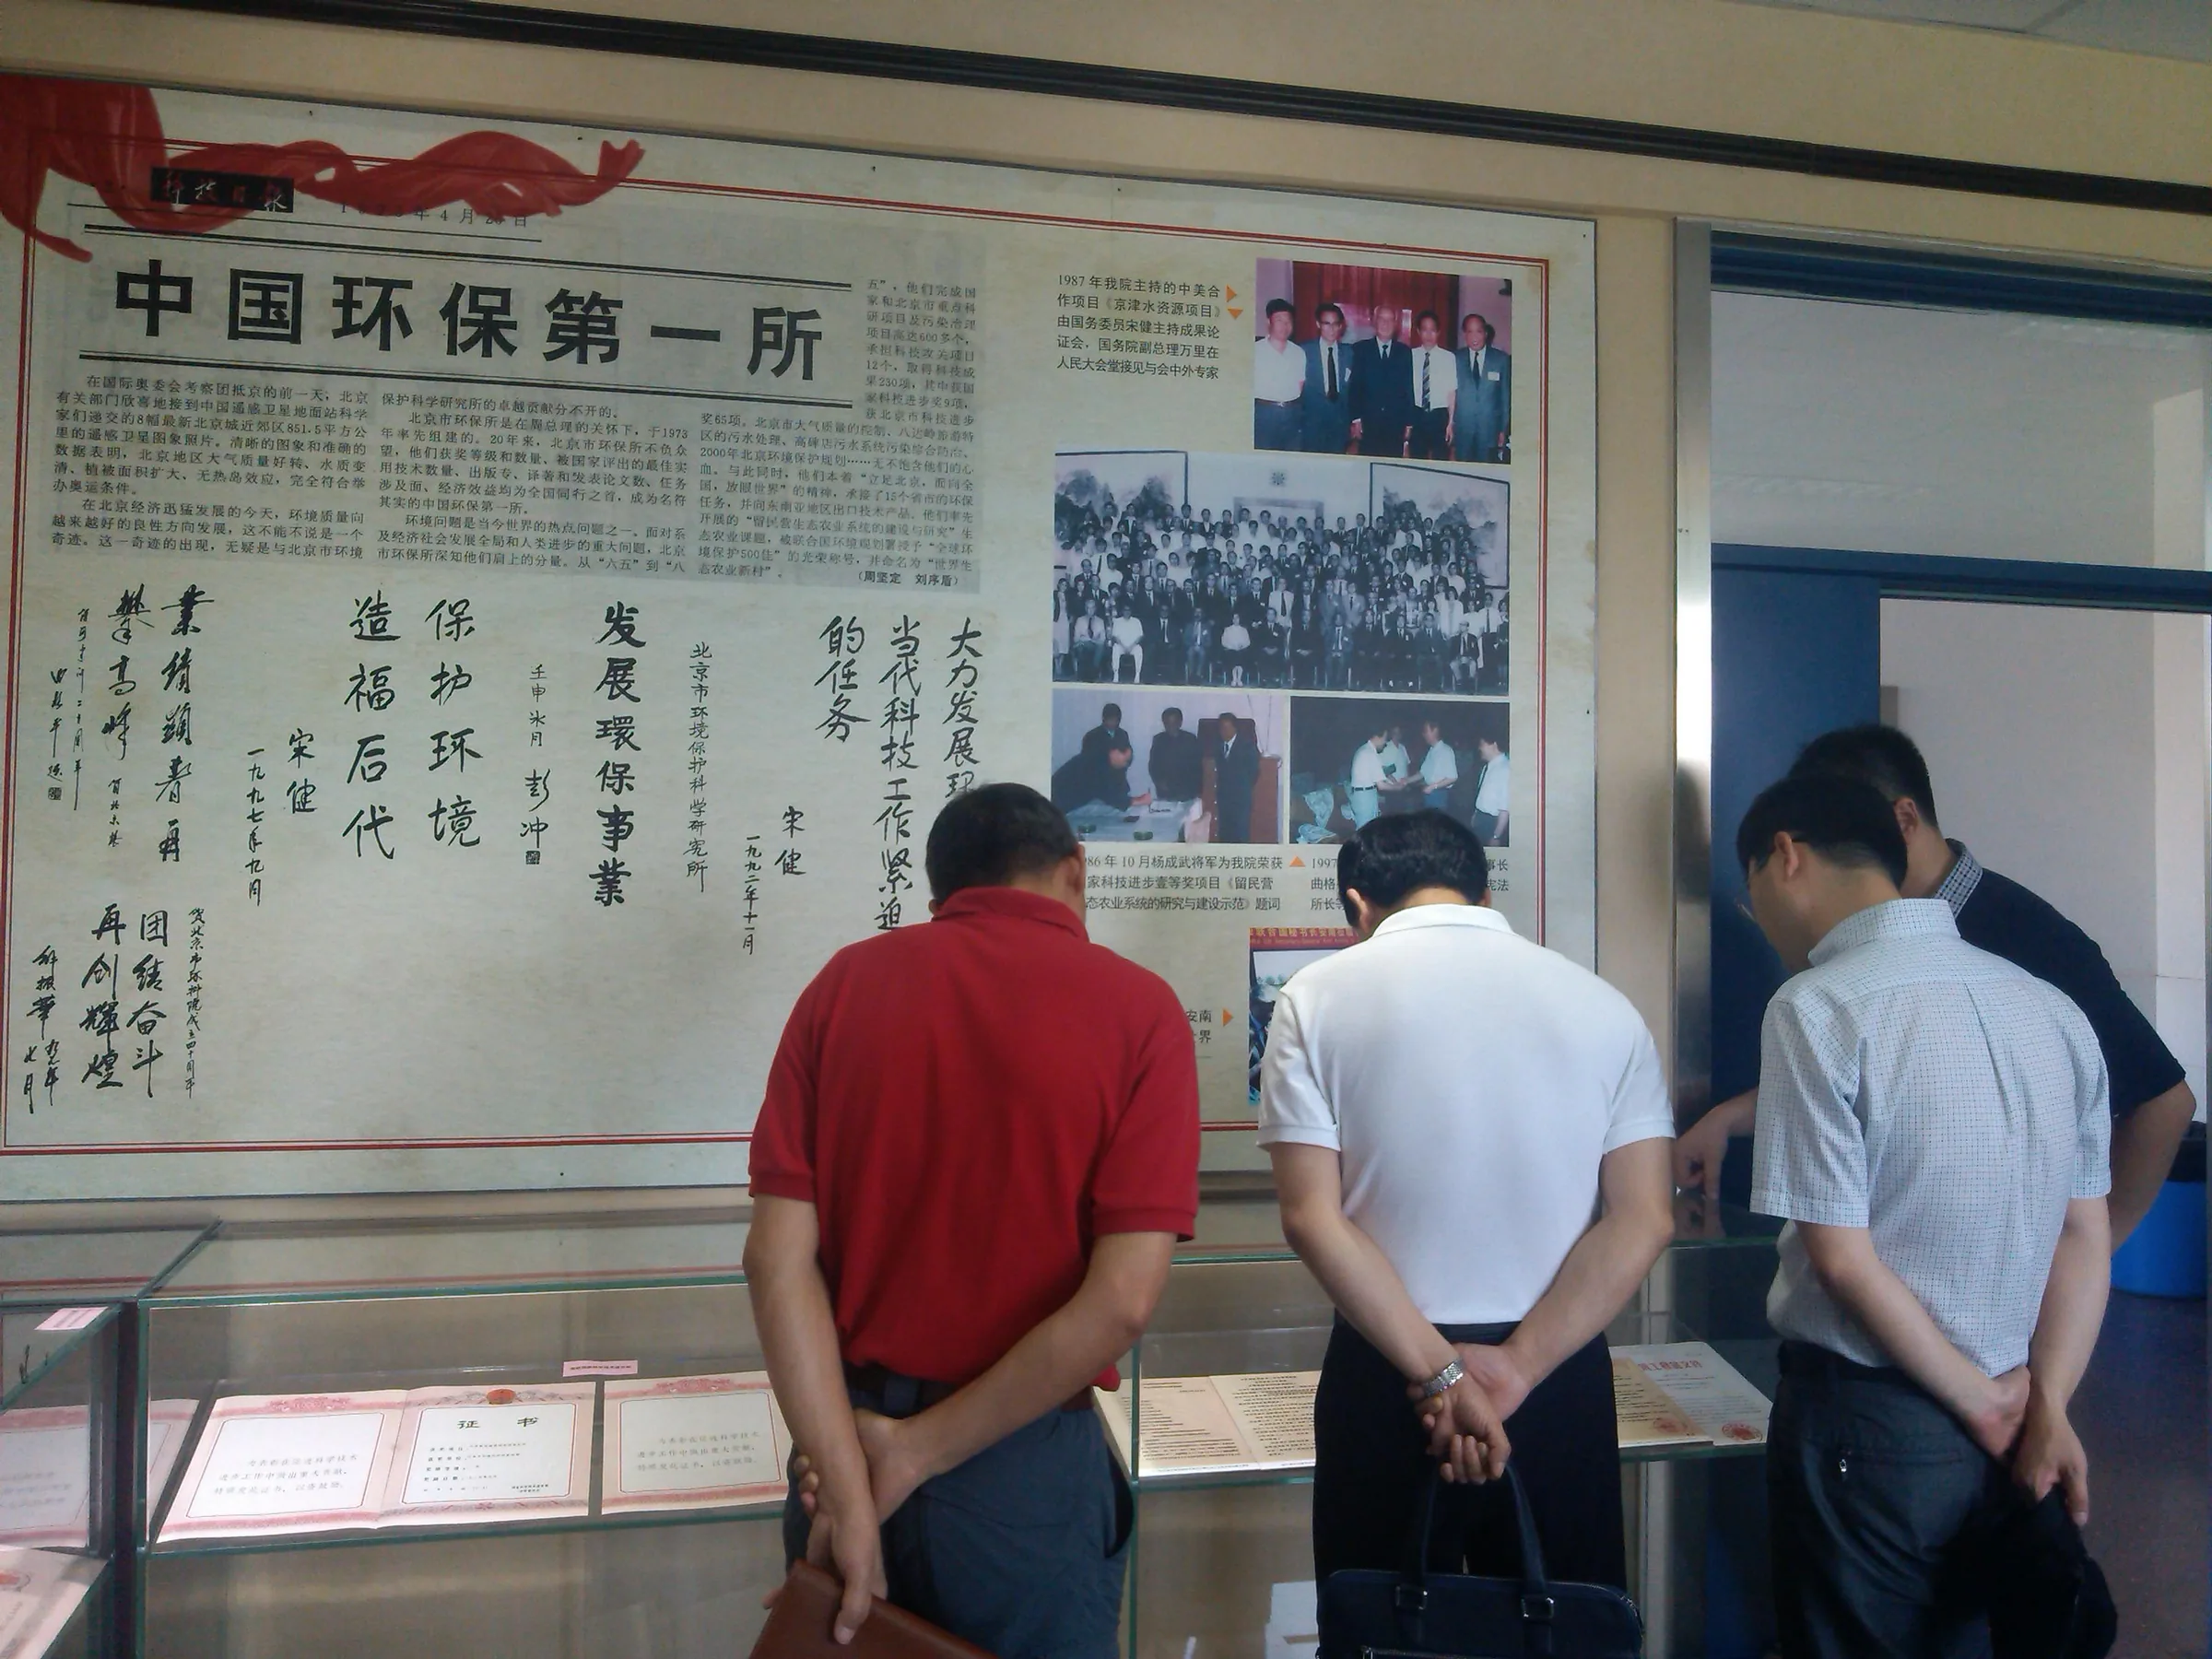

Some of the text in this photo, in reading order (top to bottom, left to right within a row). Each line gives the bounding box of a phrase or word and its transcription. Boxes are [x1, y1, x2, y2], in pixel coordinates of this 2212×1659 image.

[116, 259, 822, 382] 中国环保第一所
[424, 597, 484, 848] 保护环境
[815, 615, 871, 743] 的任务
[341, 590, 401, 860] 造福后代
[683, 641, 712, 893] 北京市环境保护科学研究所
[286, 727, 318, 815] 宋健
[774, 805, 806, 876] 宋健
[1085, 854, 1283, 869] 86年10月杨成武将军为我院荣获
[1085, 876, 1274, 890] 家科技进步壹等奖项目《留民营
[1310, 877, 1338, 890] 曲格
[741, 833, 762, 956] 一九九二年十一月
[1085, 896, 1280, 911] 态农业系统的研究与建设示范》题词
[457, 1416, 539, 1430] 证书
